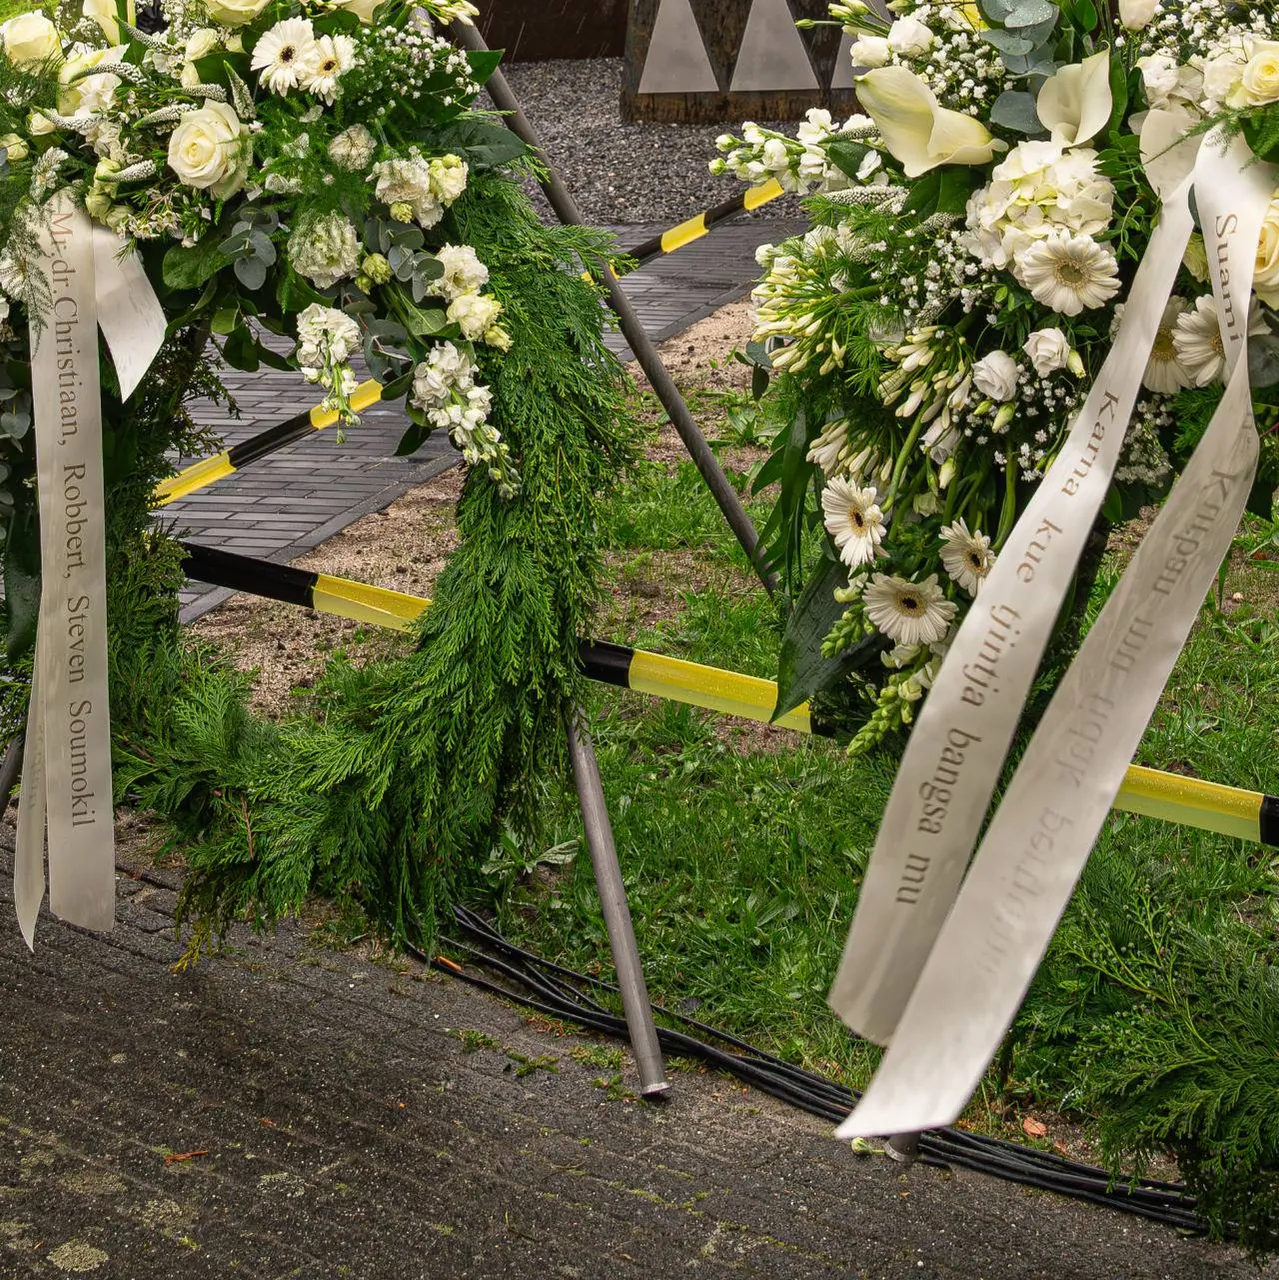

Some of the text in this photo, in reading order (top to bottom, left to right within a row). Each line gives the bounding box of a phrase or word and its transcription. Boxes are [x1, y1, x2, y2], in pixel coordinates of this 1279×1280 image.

[63, 463, 88, 579] Robbert,
[67, 595, 90, 684] Steven
[895, 390, 1120, 905] Karna kue tjintja bangsa mu
[69, 700, 96, 827] Soumokil
